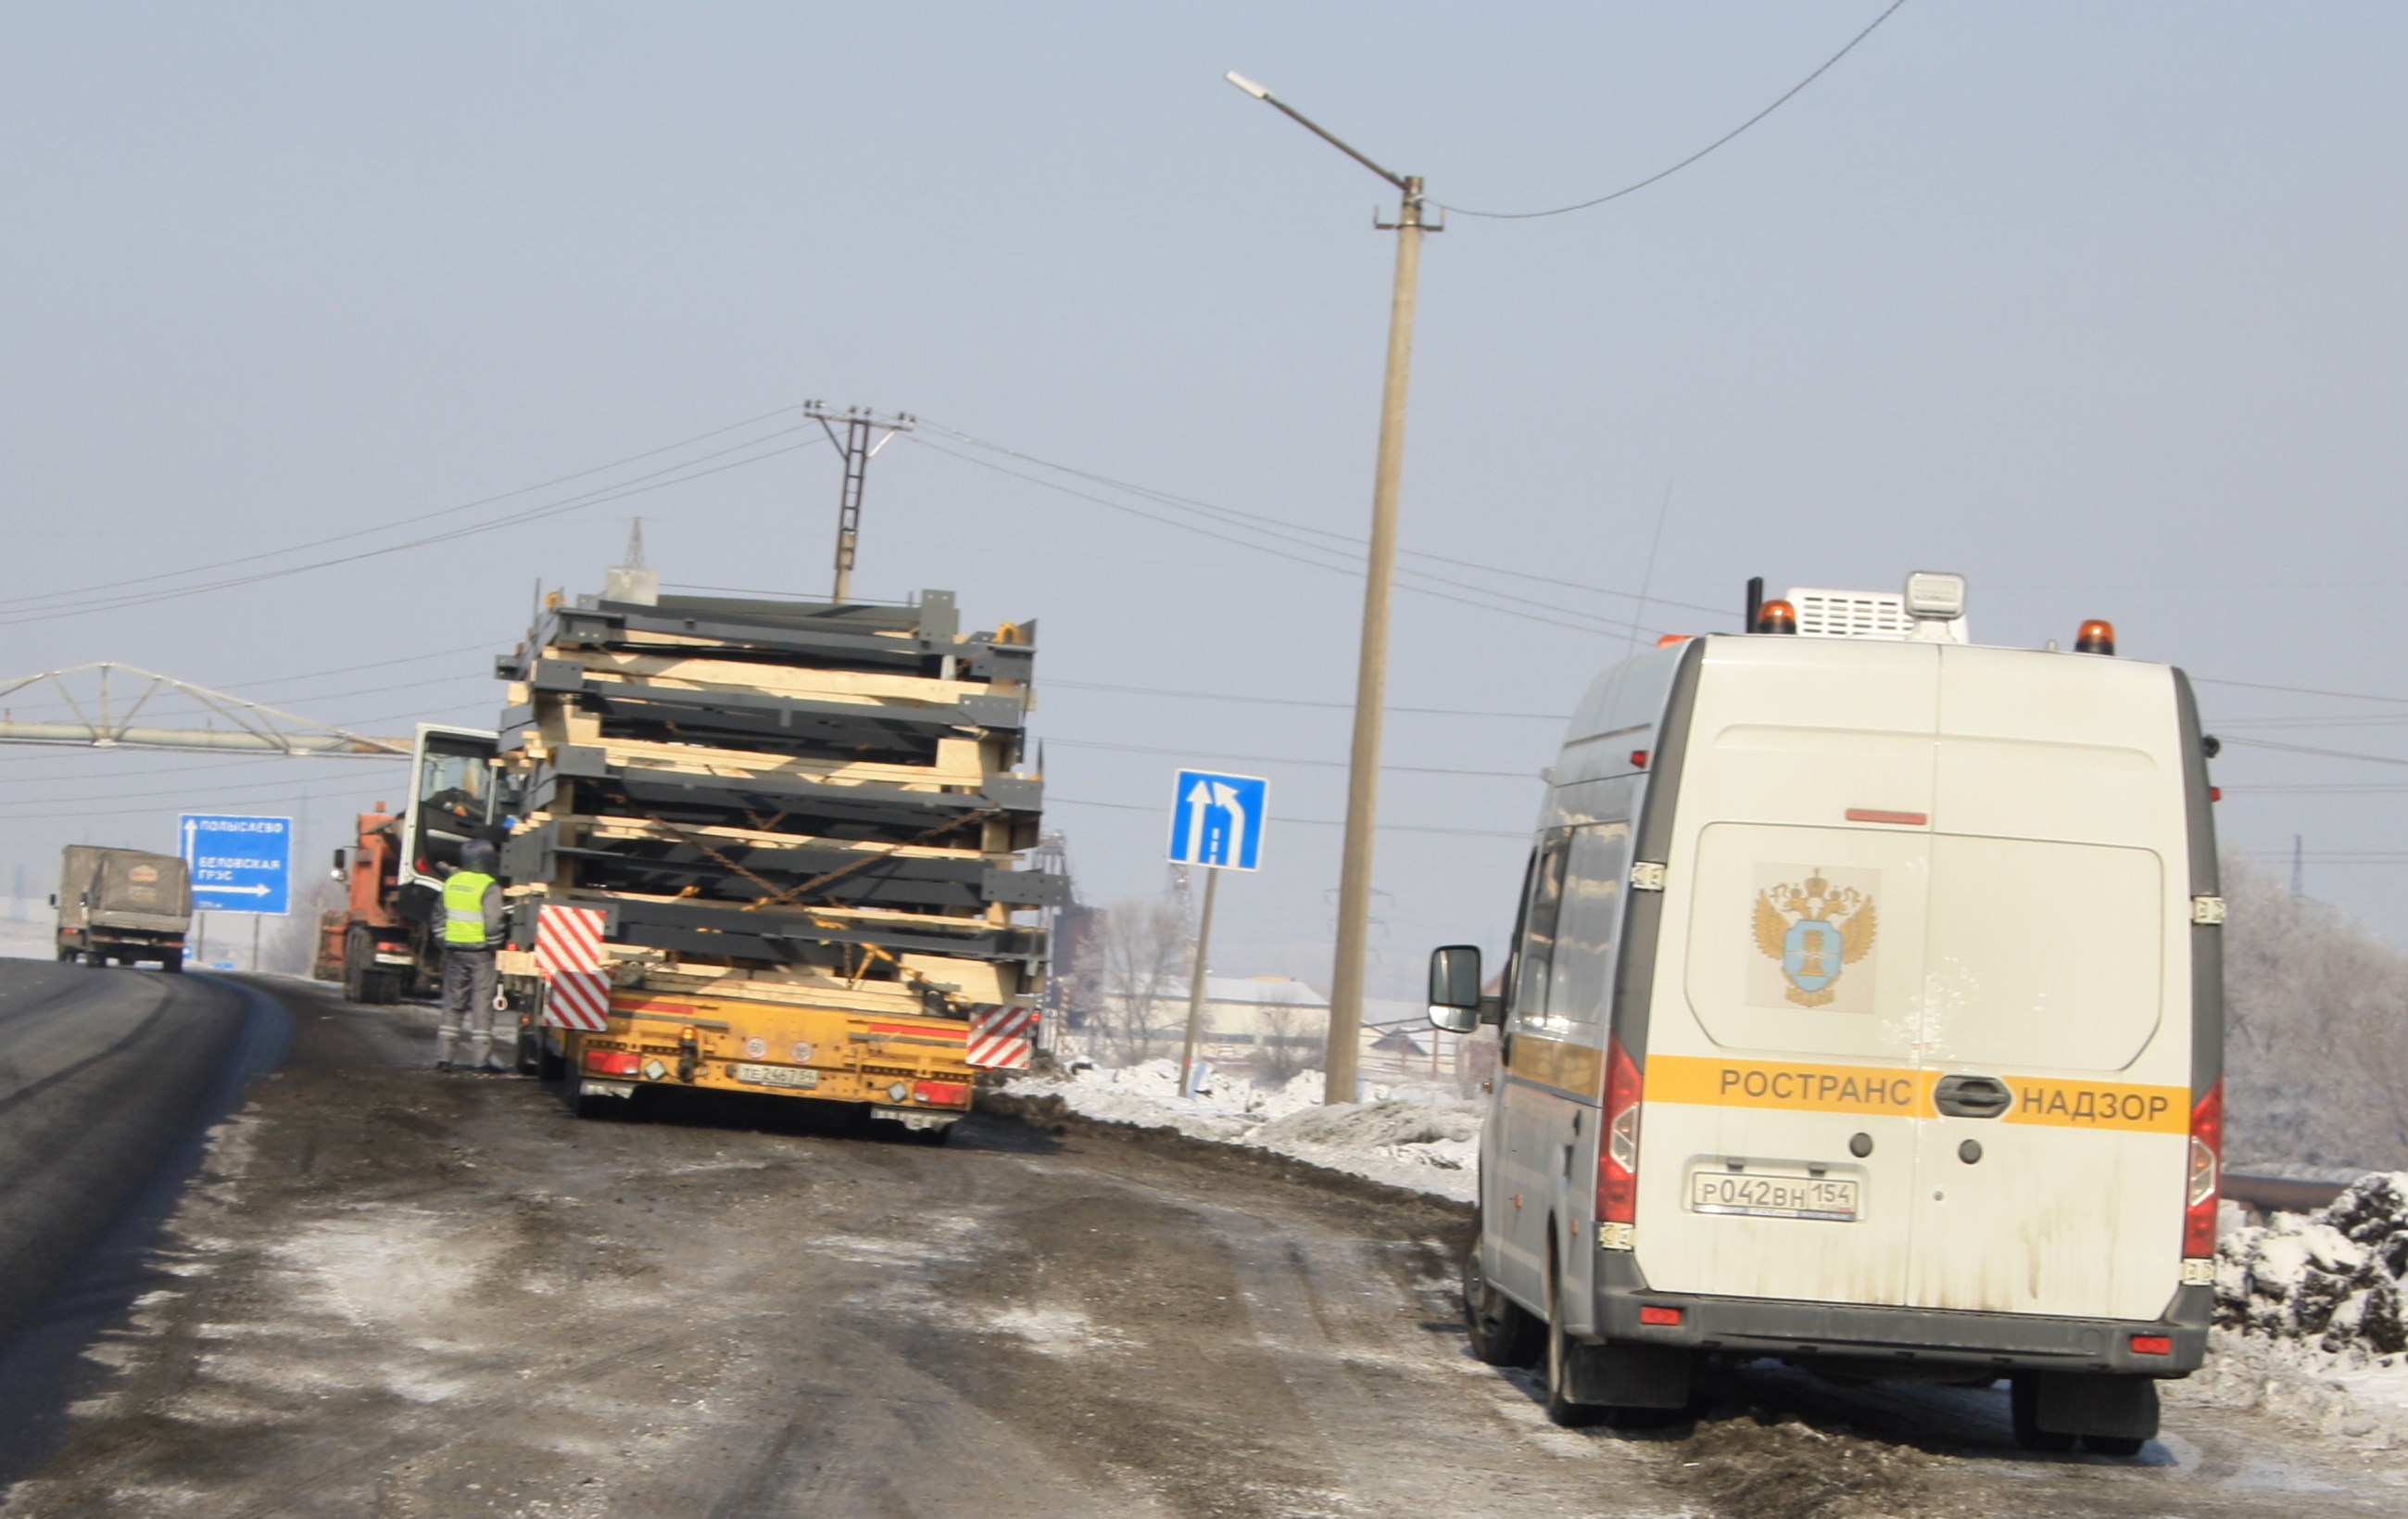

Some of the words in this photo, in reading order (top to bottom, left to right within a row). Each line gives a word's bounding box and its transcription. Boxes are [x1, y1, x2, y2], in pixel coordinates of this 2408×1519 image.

[199, 820, 284, 833] ПОЛЫСАЕВО
[198, 857, 281, 869] БЕЛОВСКАЯ
[197, 870, 233, 880] ГРЭС
[1721, 1069, 1913, 1107] РОСТРАНС
[2022, 1086, 2169, 1122] НАДЗОР
